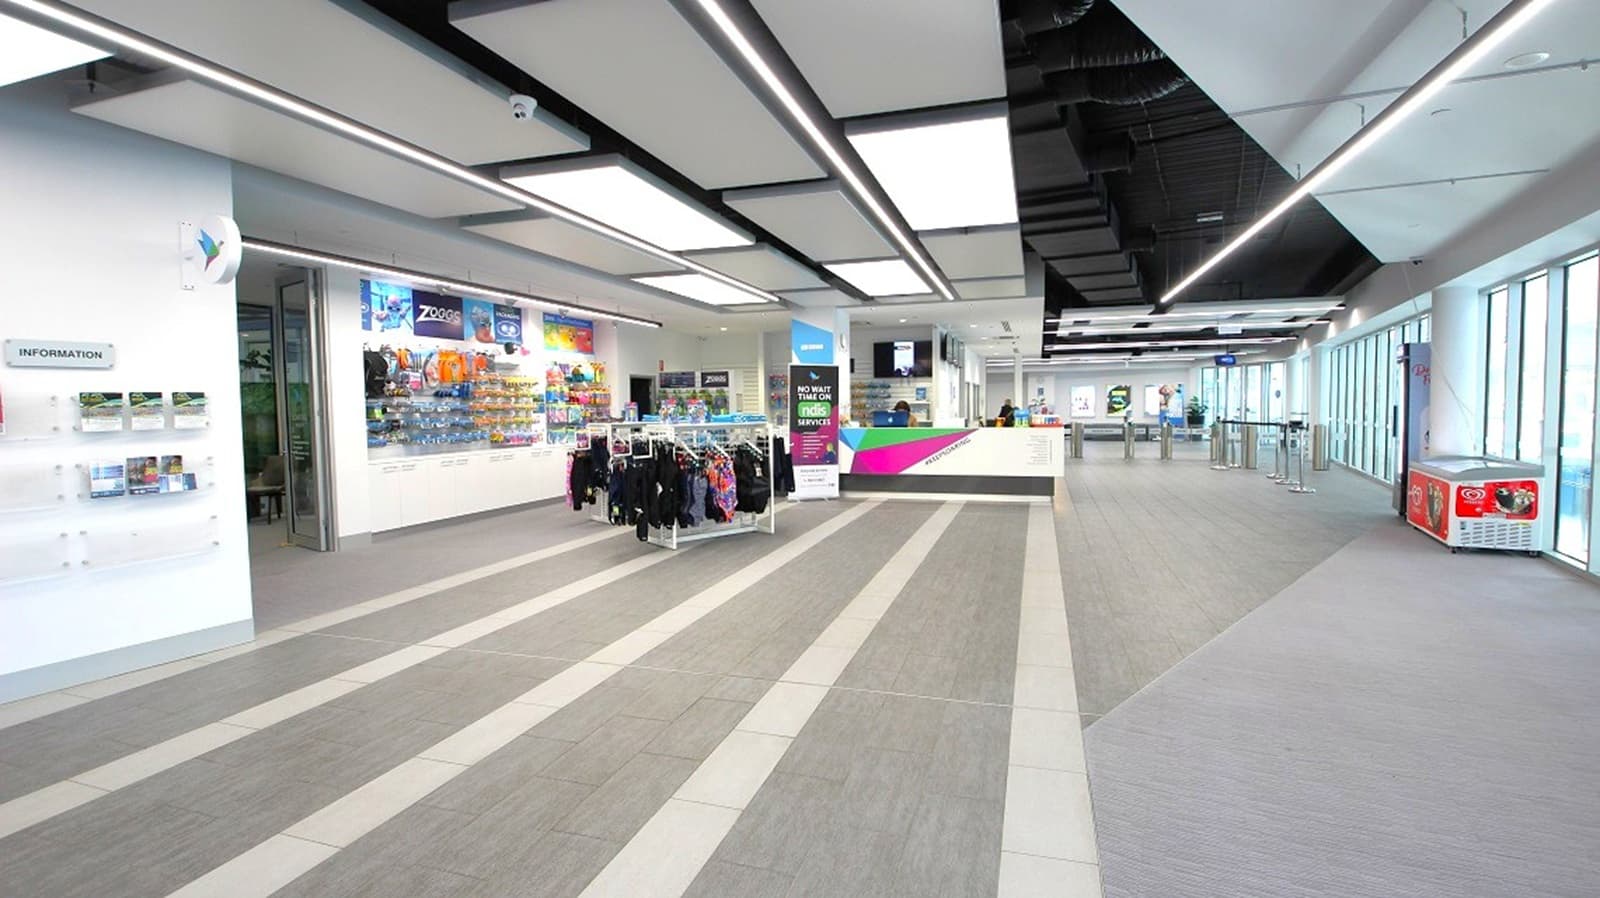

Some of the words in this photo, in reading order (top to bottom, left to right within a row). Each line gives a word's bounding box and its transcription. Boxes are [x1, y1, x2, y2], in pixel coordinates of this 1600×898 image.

[416, 304, 461, 325] ZOGGS
[19, 348, 103, 359] INFORMATION
[802, 403, 827, 417] ndis
